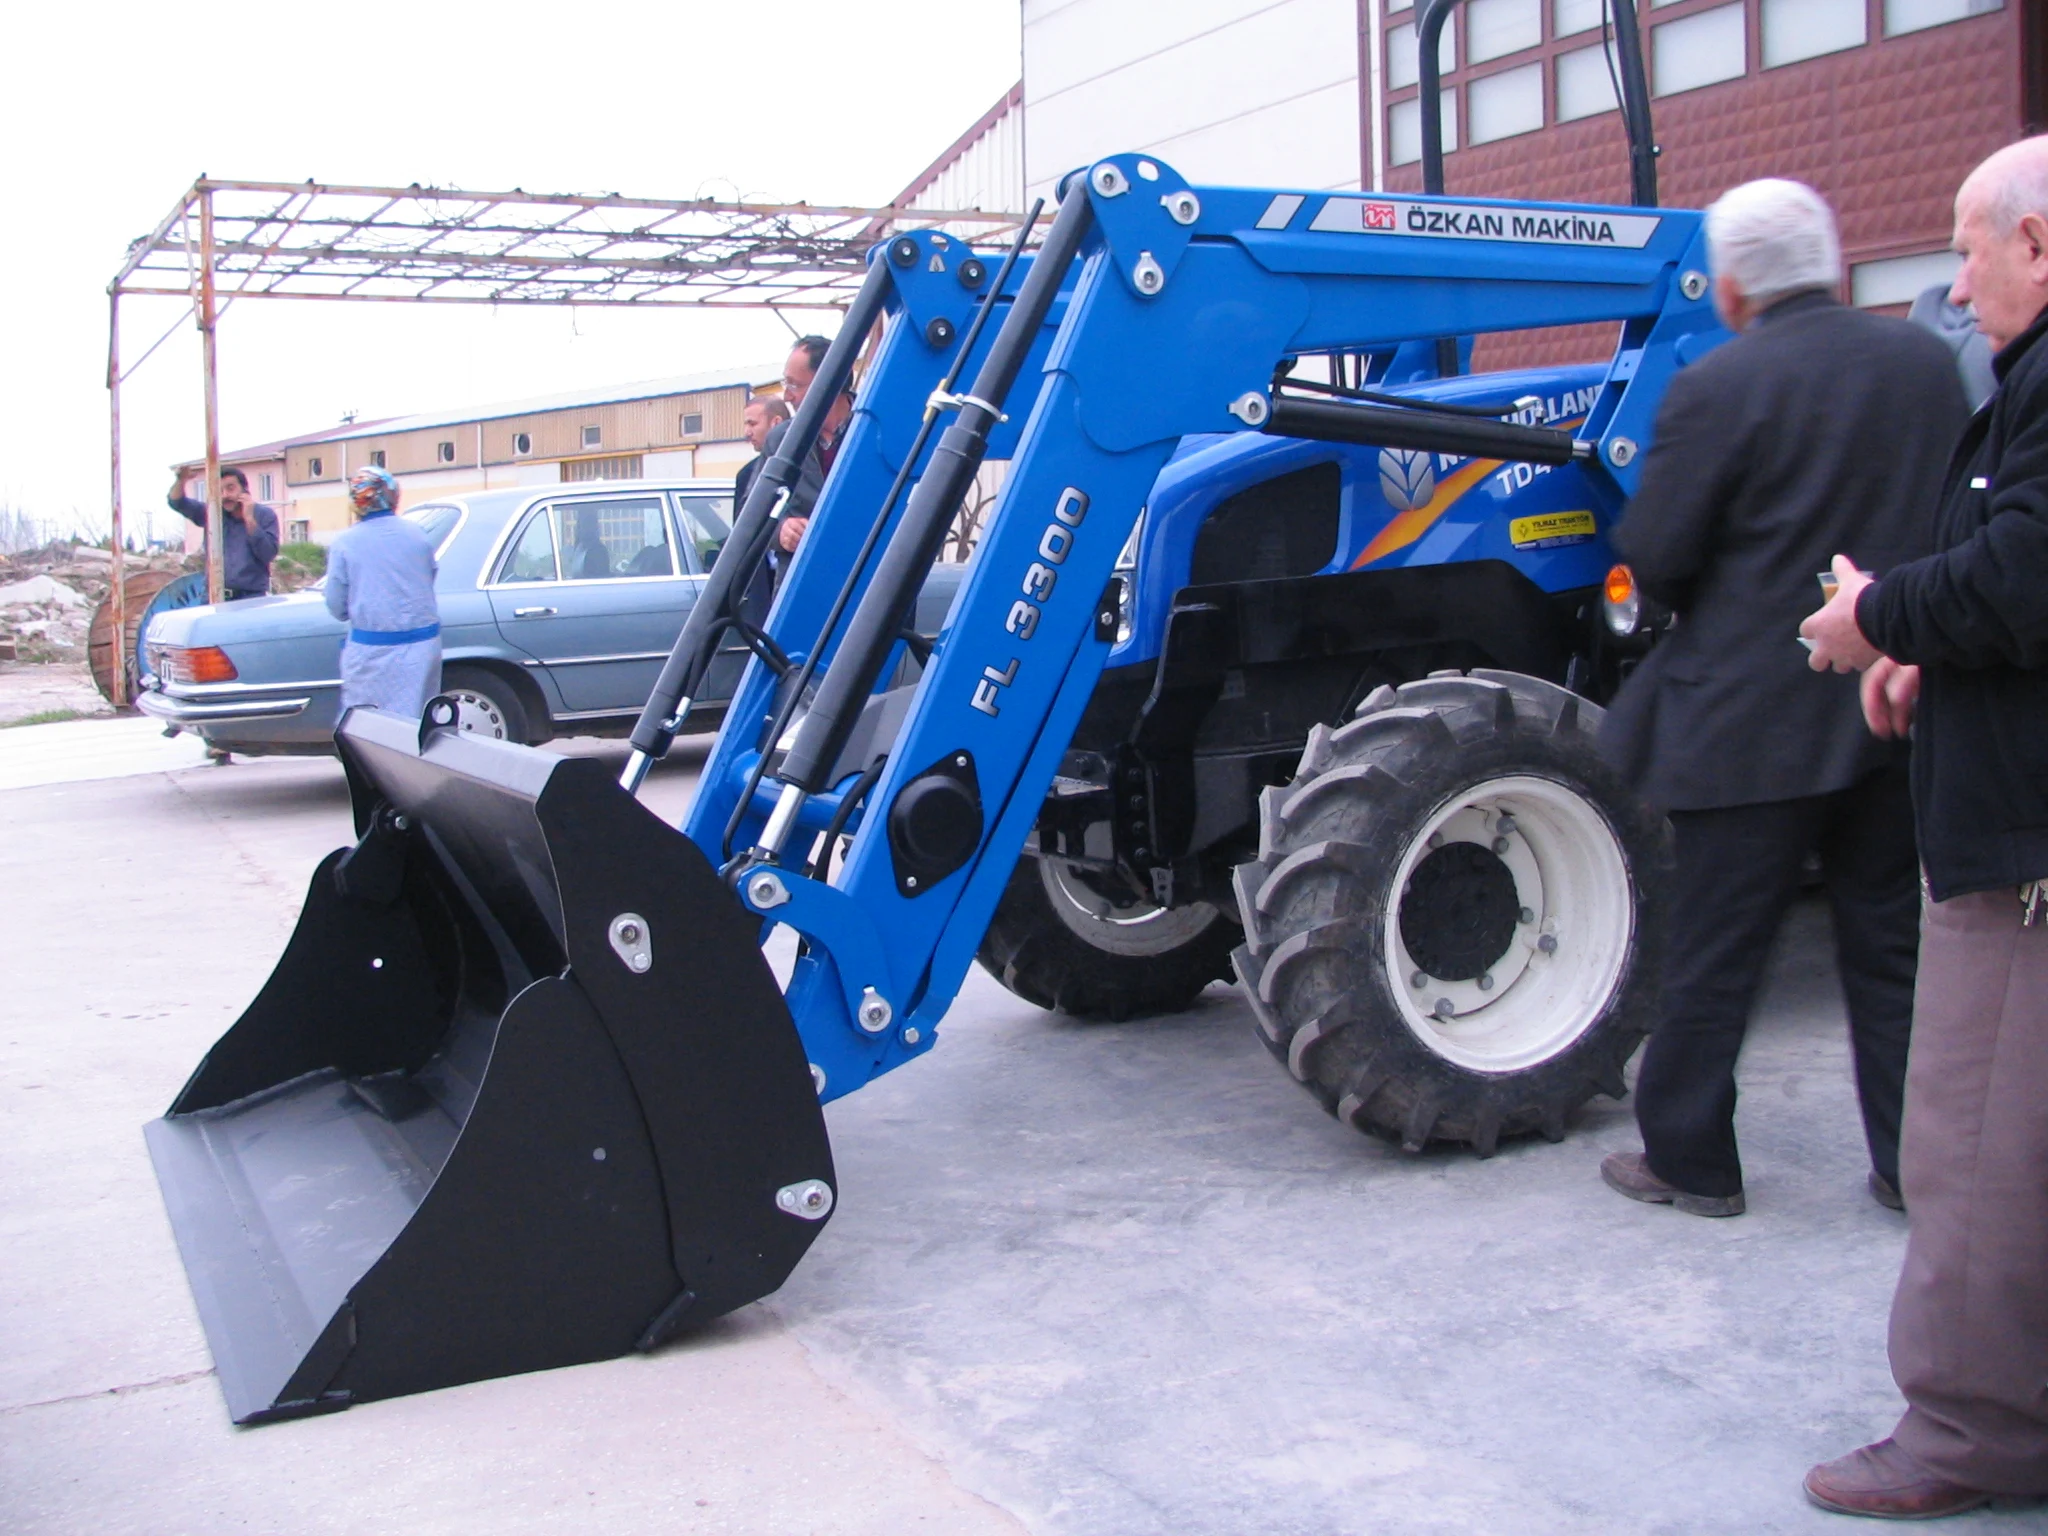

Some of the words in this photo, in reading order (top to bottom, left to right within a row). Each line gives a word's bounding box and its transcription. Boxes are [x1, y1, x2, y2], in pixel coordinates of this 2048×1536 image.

[1407, 205, 1503, 236] ÖZKAN
[1512, 215, 1615, 242] MAKİNA
[1500, 384, 1603, 426] OLAN
[970, 657, 1021, 719] FL
[1004, 485, 1091, 641] 3300
